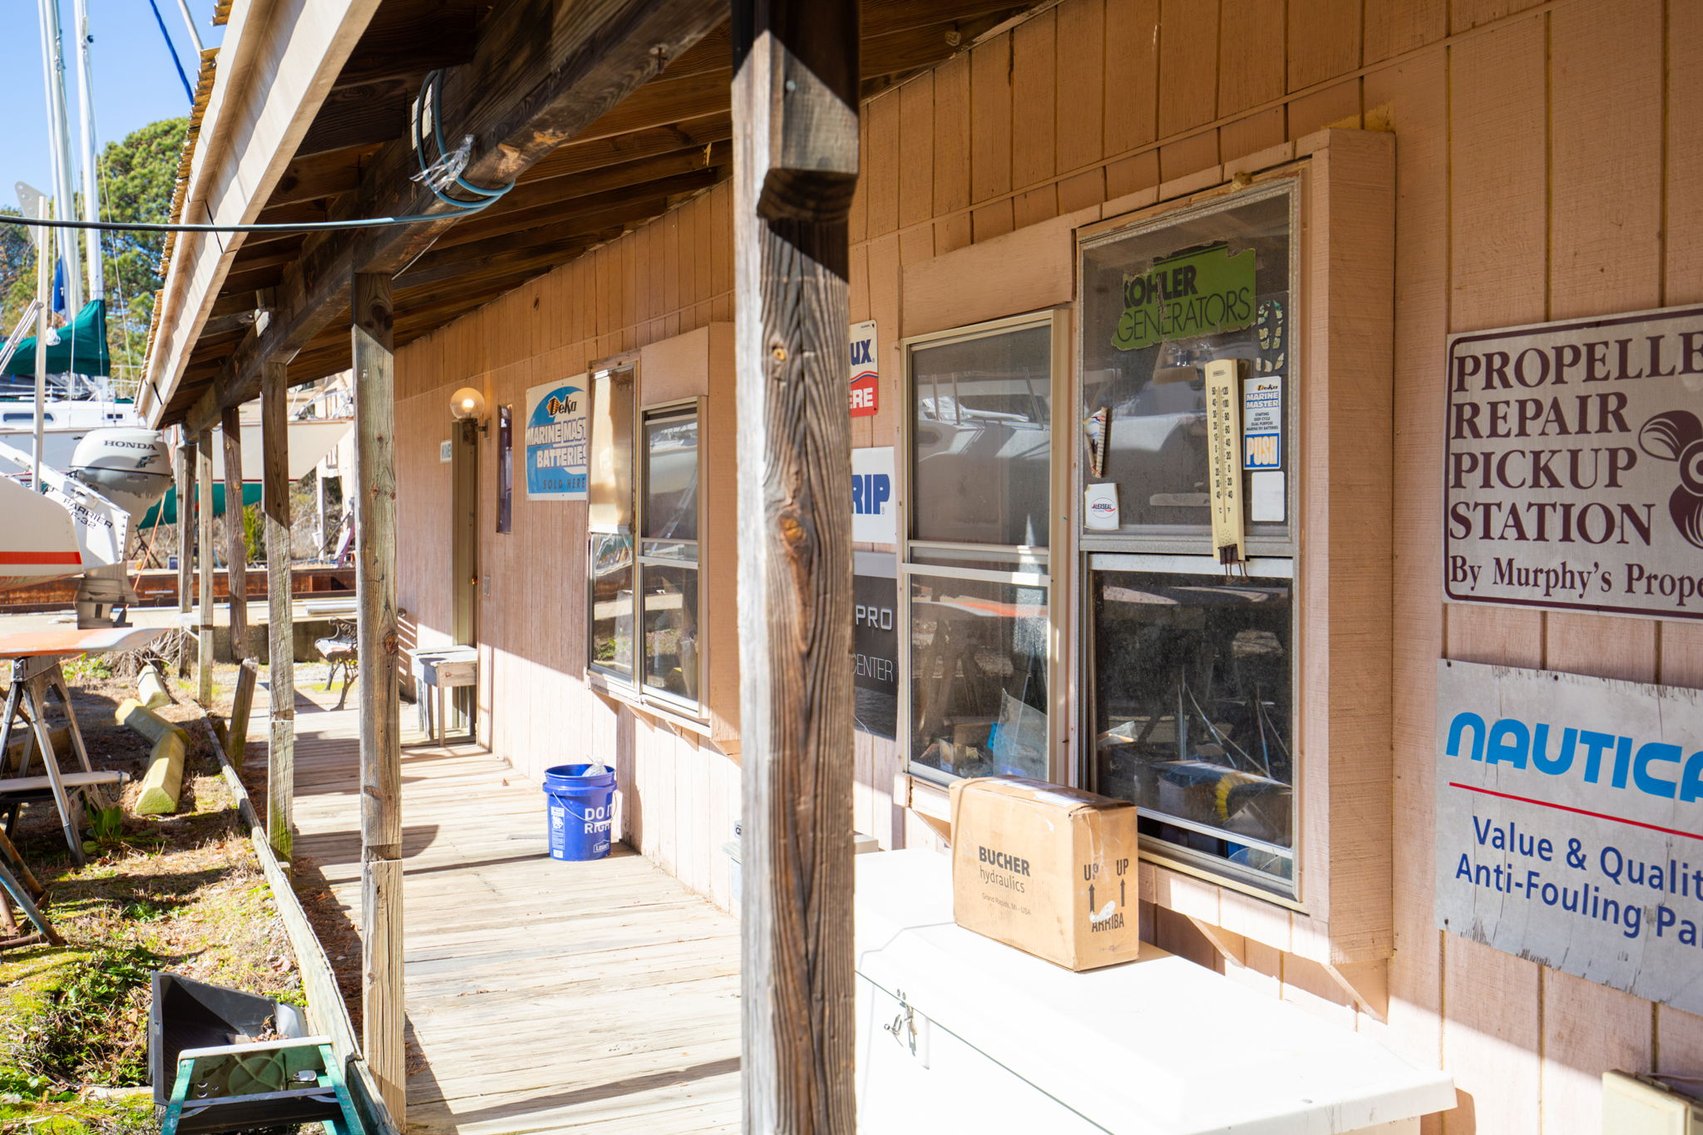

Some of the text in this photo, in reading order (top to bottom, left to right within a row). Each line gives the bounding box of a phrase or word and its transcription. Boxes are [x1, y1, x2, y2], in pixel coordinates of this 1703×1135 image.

[1116, 286, 1251, 343] GENERATORS
[1453, 332, 1703, 393] PROPELLE
[549, 396, 577, 416] Deka
[850, 388, 873, 409] RE
[1246, 391, 1279, 401] MARINE
[1246, 400, 1279, 410] MASTER
[1451, 391, 1631, 440] REPAIR
[104, 440, 157, 450] HONDA
[527, 422, 561, 446] MARINE
[1246, 435, 1278, 465] PUSH
[1450, 447, 1637, 489] PICKUP
[543, 477, 585, 490] SOLD HERE
[1450, 501, 1656, 546] STATION
[1450, 555, 1703, 607] By Murphy's Prope
[855, 605, 893, 631] PRO
[584, 806, 605, 821] DO
[584, 823, 609, 834] RIGH
[978, 846, 1031, 877] BUCHER
[1116, 858, 1129, 876] UP
[1473, 816, 1703, 902] Value & Qualit
[980, 866, 1025, 894] hydraulics
[1456, 853, 1703, 948] Anti-Fouling Pa
[1091, 912, 1125, 933] ARRIBA
